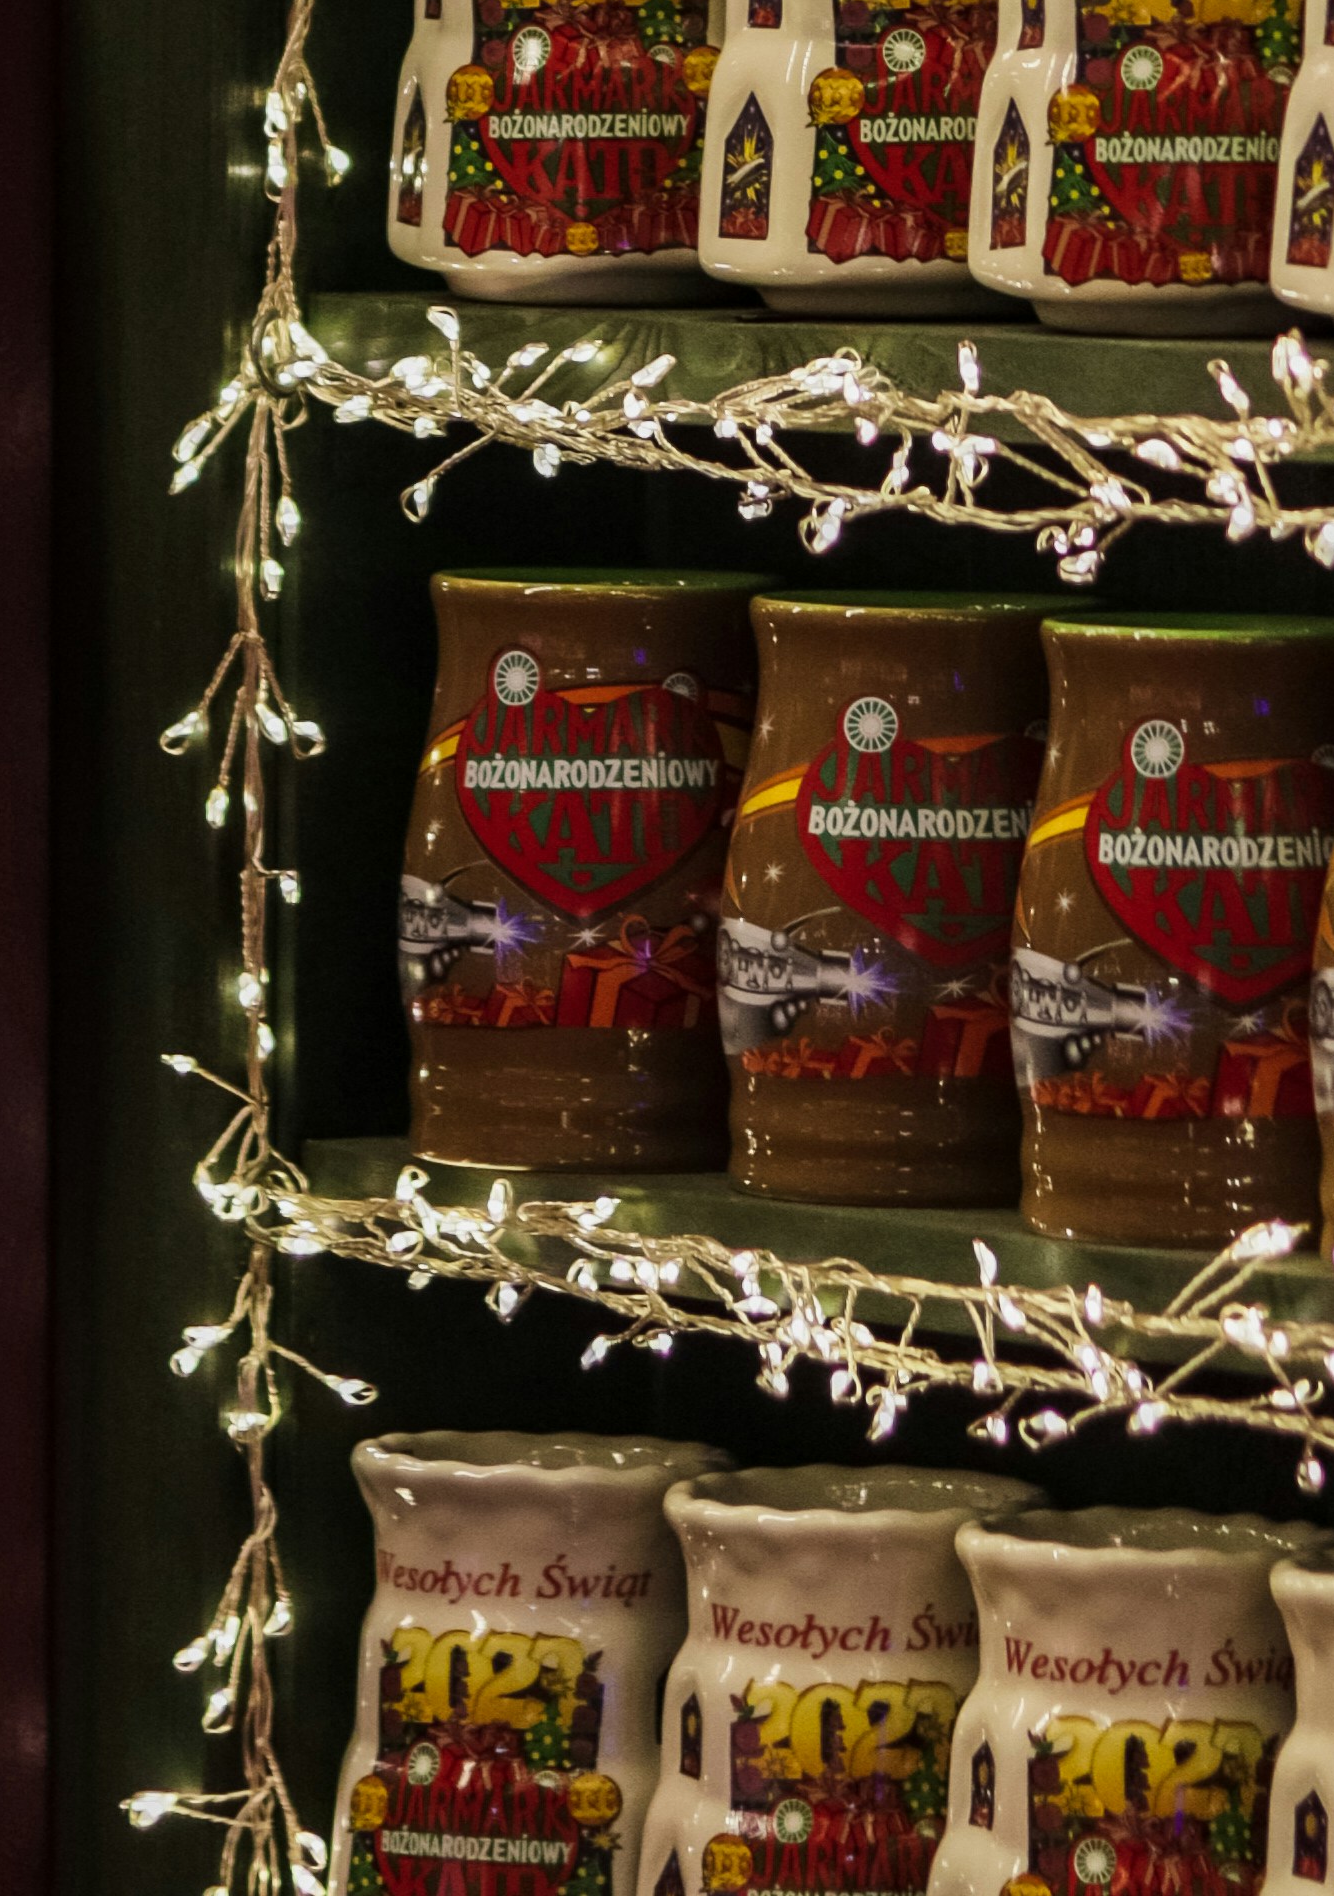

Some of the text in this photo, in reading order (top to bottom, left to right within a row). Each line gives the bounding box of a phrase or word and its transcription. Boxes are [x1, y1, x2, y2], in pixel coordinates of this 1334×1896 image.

[378, 1549, 652, 1607] Wesołych Świąt
[712, 1603, 892, 1659] Wesołych
[1004, 1635, 1189, 1695] Wesołych
